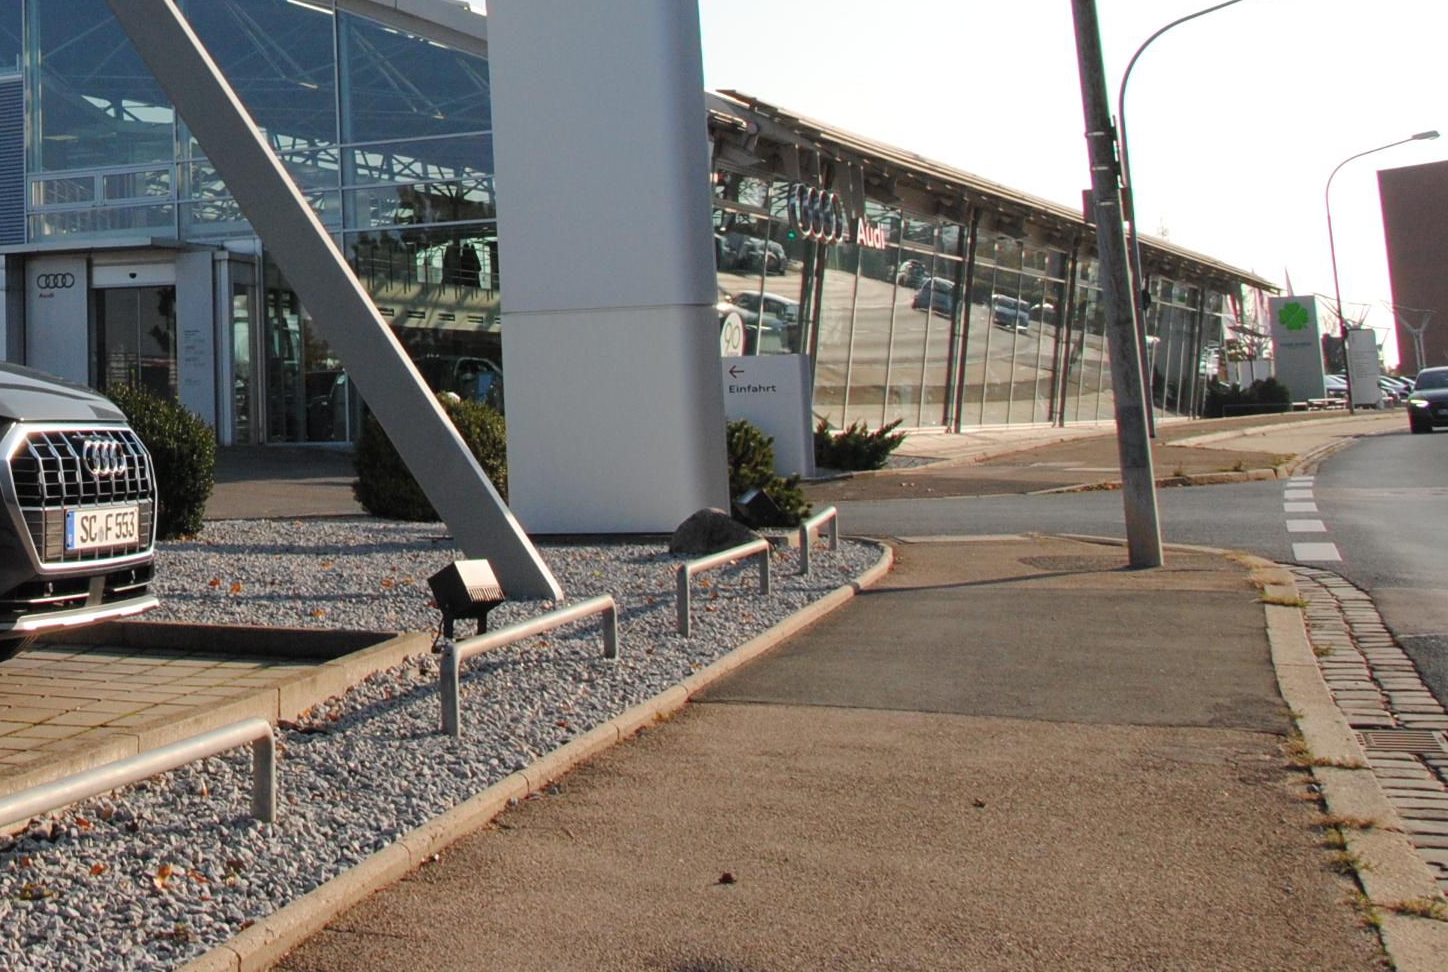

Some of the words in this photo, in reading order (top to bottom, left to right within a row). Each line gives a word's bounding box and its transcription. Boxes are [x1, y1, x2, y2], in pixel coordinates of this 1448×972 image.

[857, 217, 888, 250] Audi
[728, 384, 777, 394] Einfahrt
[80, 515, 97, 543] SC
[105, 513, 114, 541] F
[115, 511, 135, 539] 553
